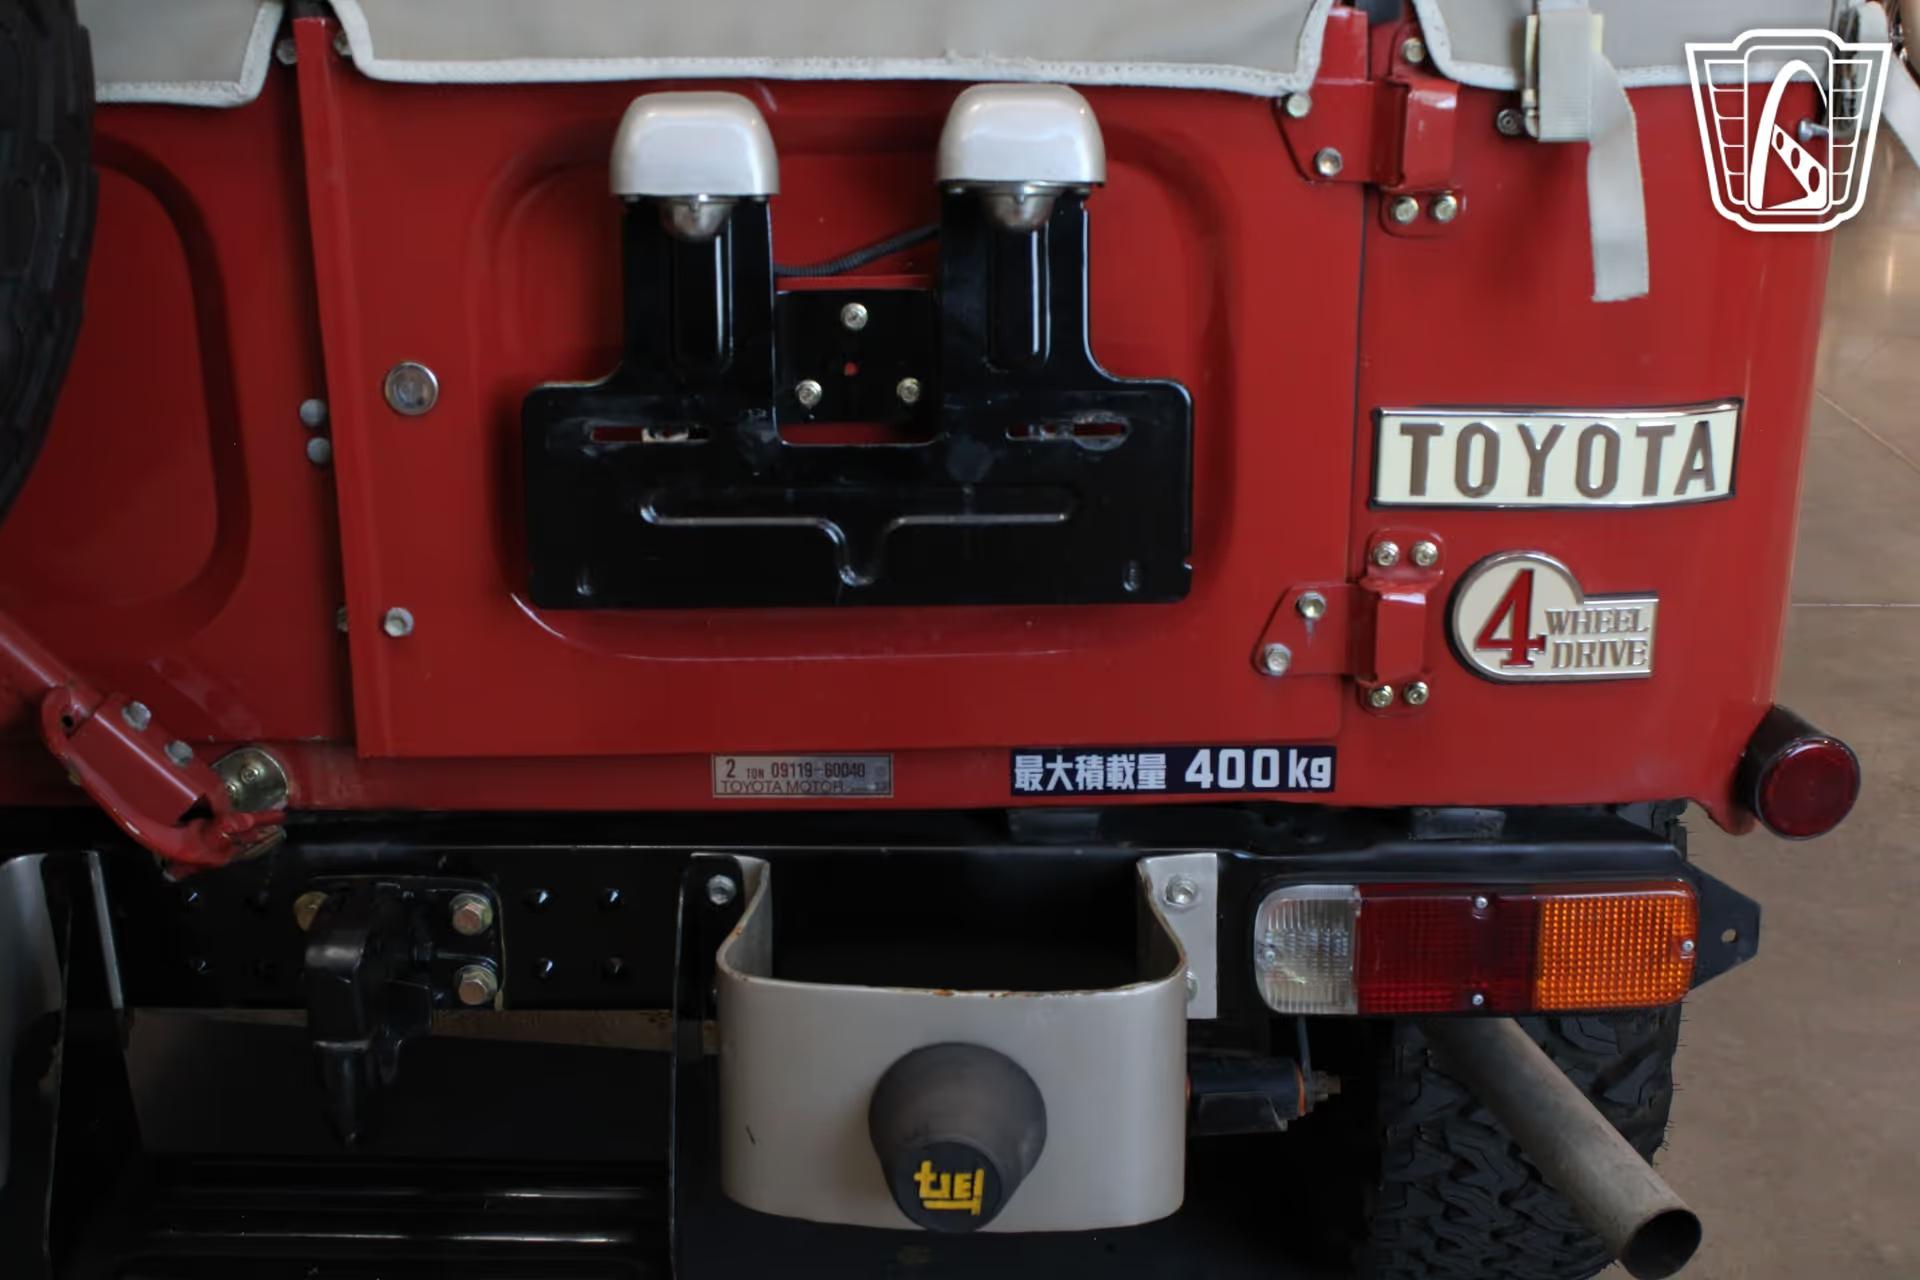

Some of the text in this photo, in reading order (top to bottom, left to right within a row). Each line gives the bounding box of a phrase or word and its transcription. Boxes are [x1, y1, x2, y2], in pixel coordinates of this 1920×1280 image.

[1399, 419, 1717, 499] TOYOTA
[1473, 567, 1650, 669] 4 WHEEL
[1551, 639, 1649, 669] DRIVE
[725, 758, 736, 779] 2
[747, 767, 765, 779] TON
[1014, 753, 1167, 792] 最大積載量
[721, 780, 784, 793] TOYOTA
[786, 780, 844, 794] MOTOR
